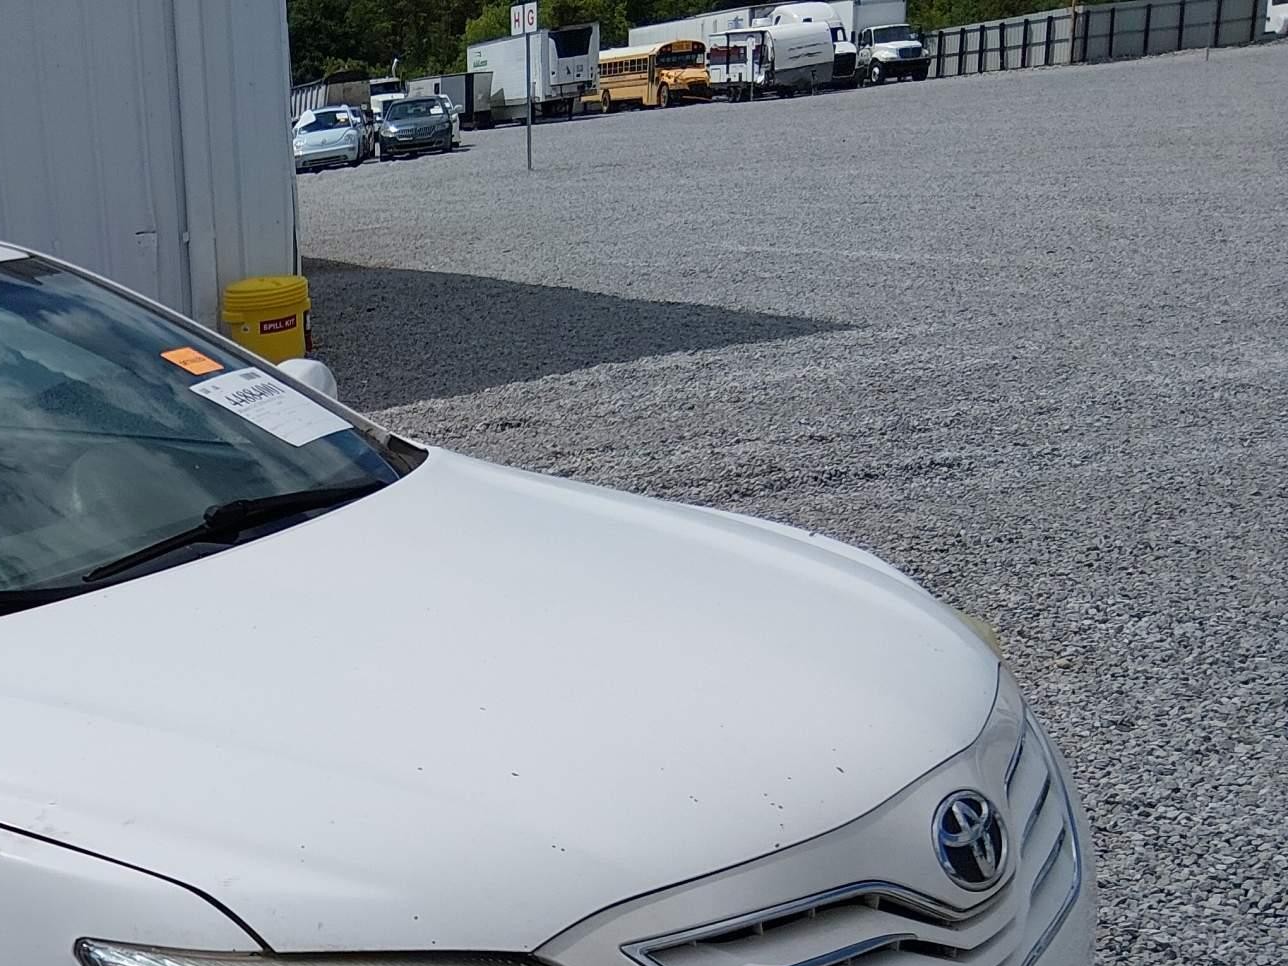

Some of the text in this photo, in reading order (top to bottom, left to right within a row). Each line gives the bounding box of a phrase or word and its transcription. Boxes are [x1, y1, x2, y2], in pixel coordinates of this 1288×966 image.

[513, 10, 521, 28] H
[527, 9, 535, 26] G
[263, 318, 296, 331] SPILL KIT
